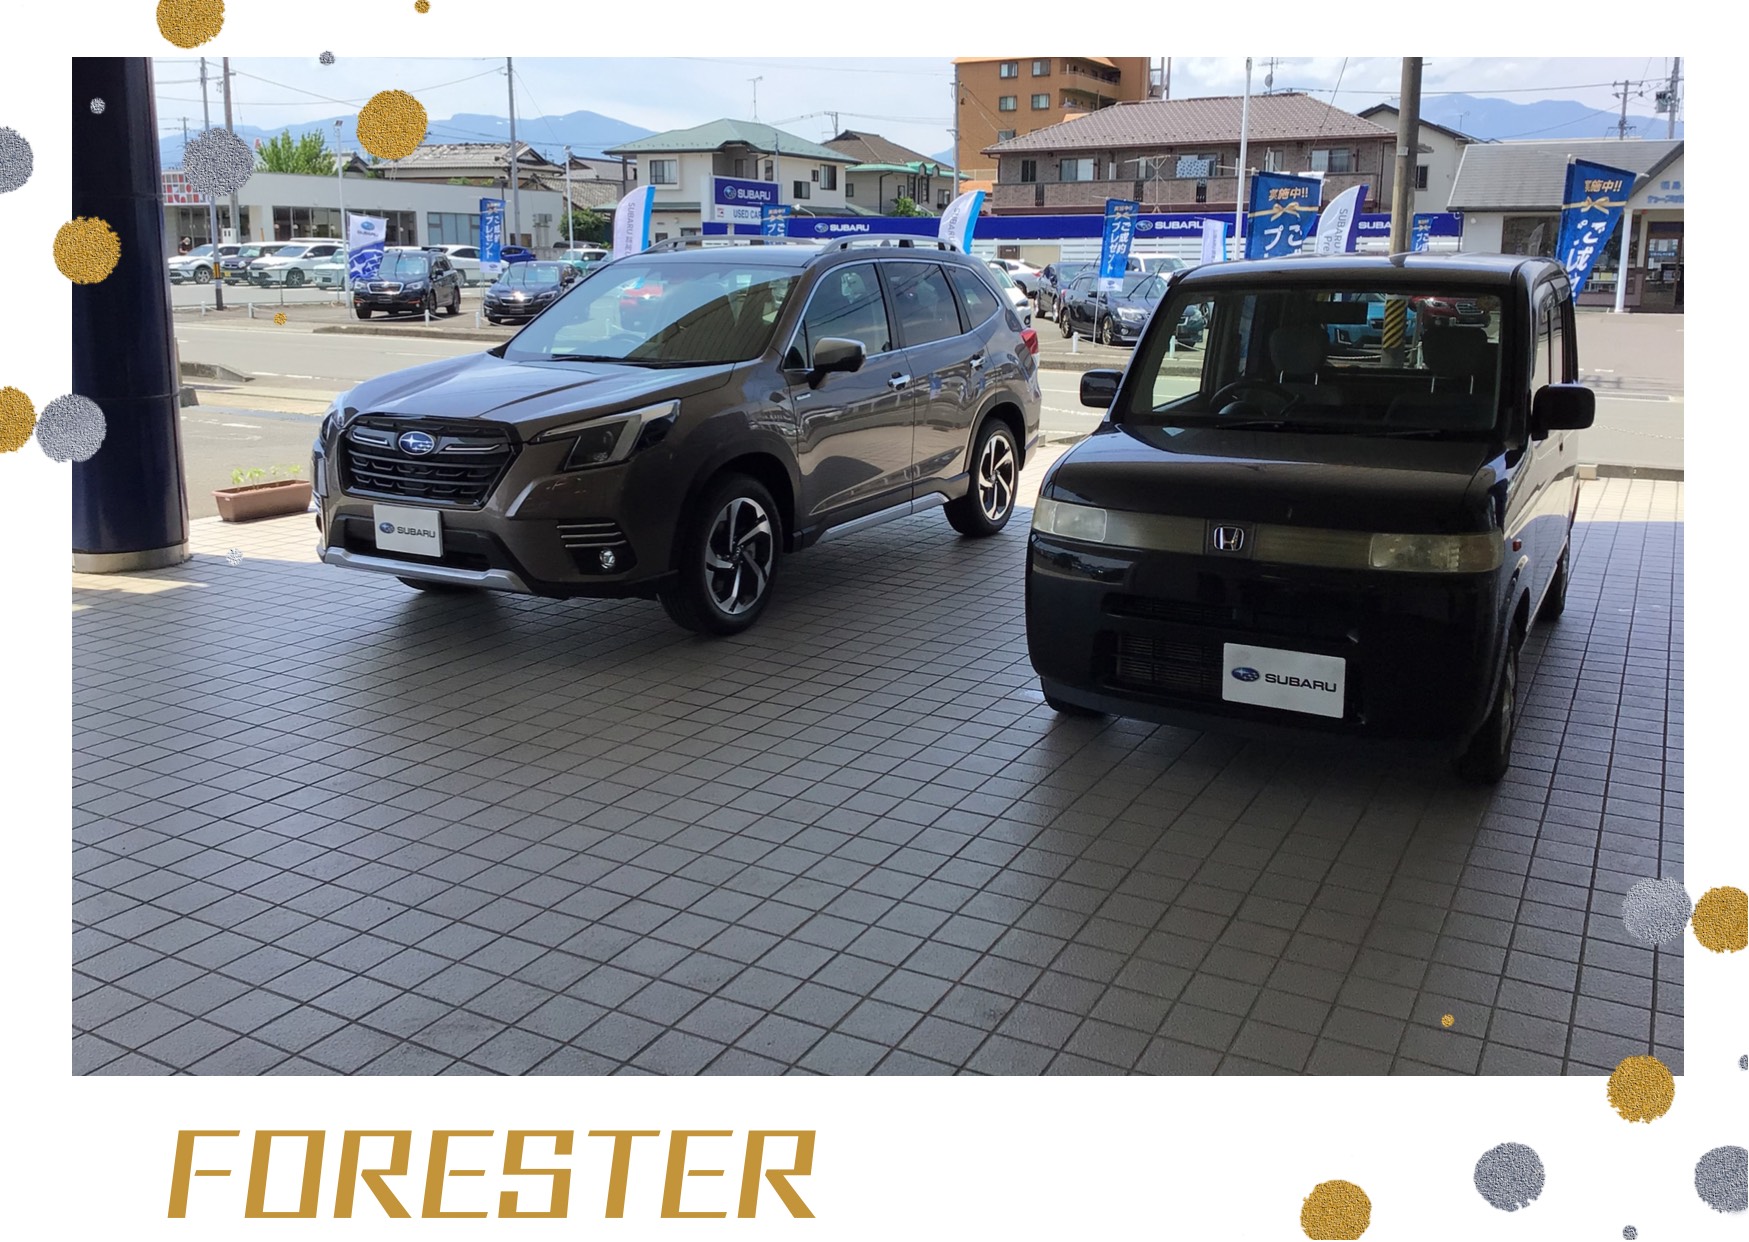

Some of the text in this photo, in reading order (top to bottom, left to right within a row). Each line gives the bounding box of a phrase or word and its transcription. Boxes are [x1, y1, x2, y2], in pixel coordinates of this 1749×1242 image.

[737, 188, 771, 201] SUBARU
[626, 202, 636, 235] SUBARU
[733, 209, 749, 219] USED
[829, 223, 870, 232] SUBARU
[1154, 221, 1205, 230] SUBARU
[1333, 208, 1349, 250] SUBARU
[396, 526, 436, 538] SUBARU
[1264, 673, 1337, 692] SUBARU
